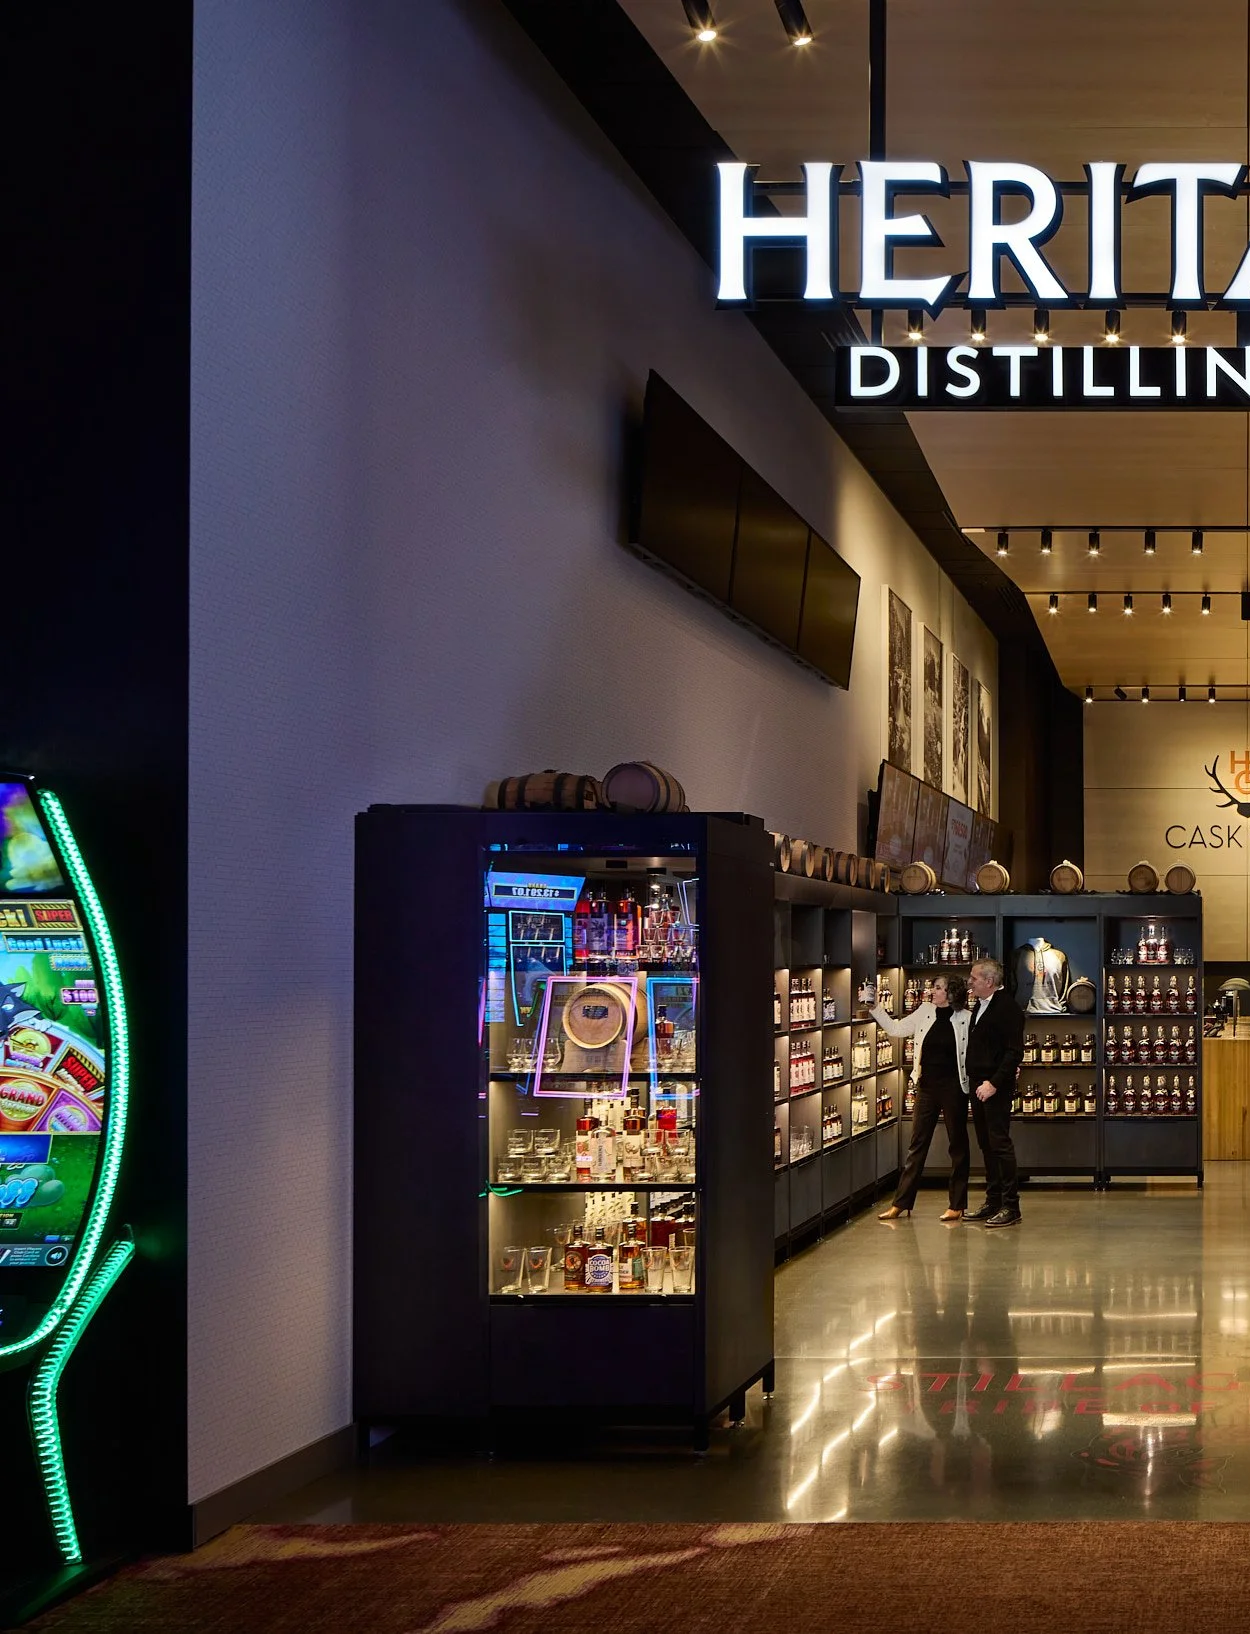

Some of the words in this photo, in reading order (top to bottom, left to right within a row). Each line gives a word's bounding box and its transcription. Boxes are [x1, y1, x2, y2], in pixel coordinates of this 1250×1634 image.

[1165, 825, 1243, 849] CASK
[35, 910, 73, 922] SUPER
[7, 937, 44, 950] Good
[62, 989, 97, 1004] $100
[62, 1055, 98, 1092] SUPER
[0, 1085, 45, 1107] GRAND
